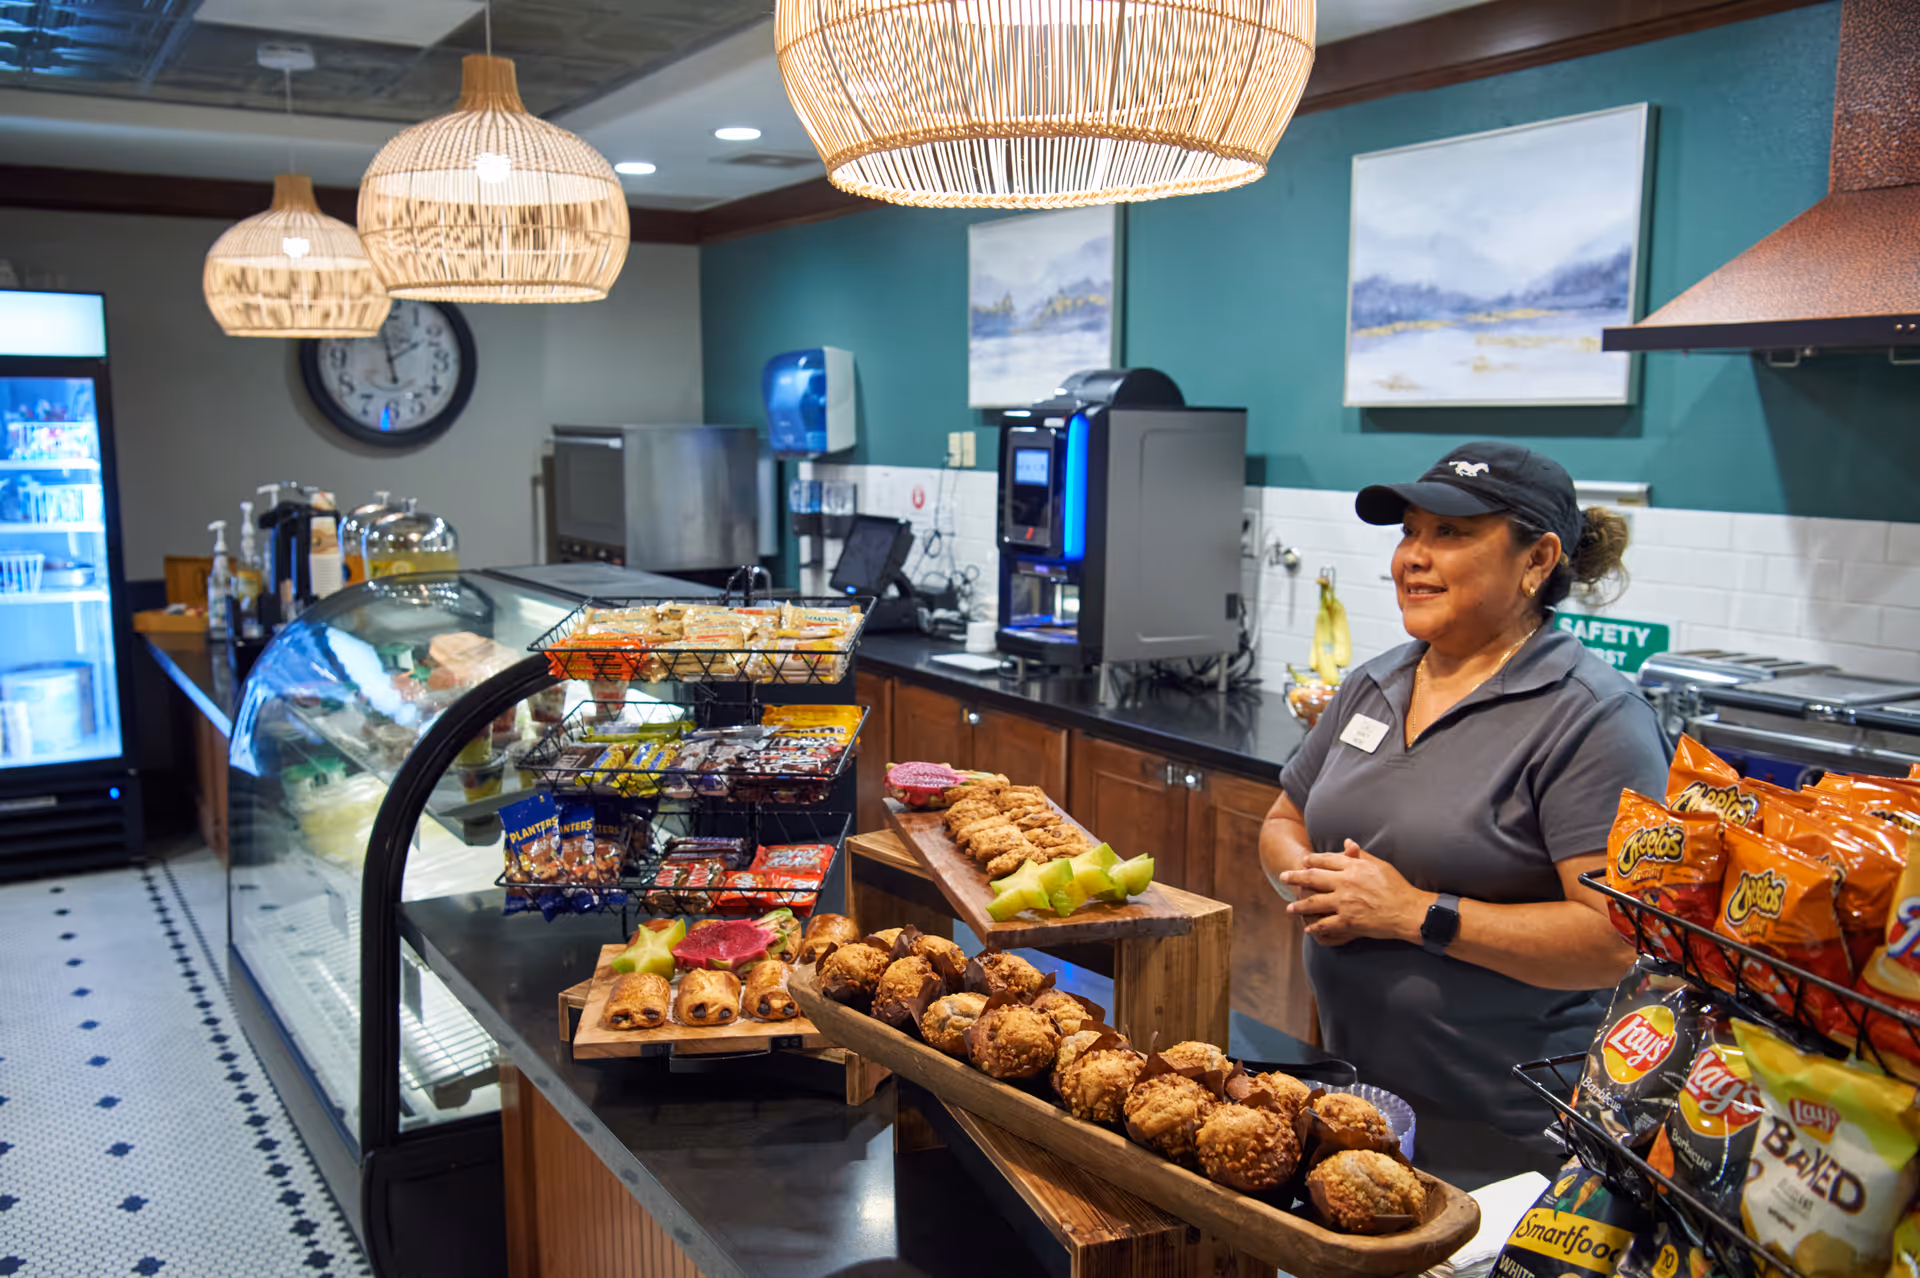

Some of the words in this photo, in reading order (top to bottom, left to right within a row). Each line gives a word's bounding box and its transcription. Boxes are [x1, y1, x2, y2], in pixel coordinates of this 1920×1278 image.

[1558, 617, 1651, 648] SAFETY
[509, 816, 559, 843] PLANTERS
[1618, 826, 1684, 876] Cheetos
[1728, 872, 1787, 924] Cheetos
[1608, 1014, 1672, 1067] Lay's
[1581, 1076, 1622, 1112] Barbecue
[1689, 1052, 1763, 1115] Lay's
[1795, 1099, 1839, 1134] Lay's
[1671, 1127, 1713, 1172] Barbecue
[1762, 1115, 1866, 1216] BAKED
